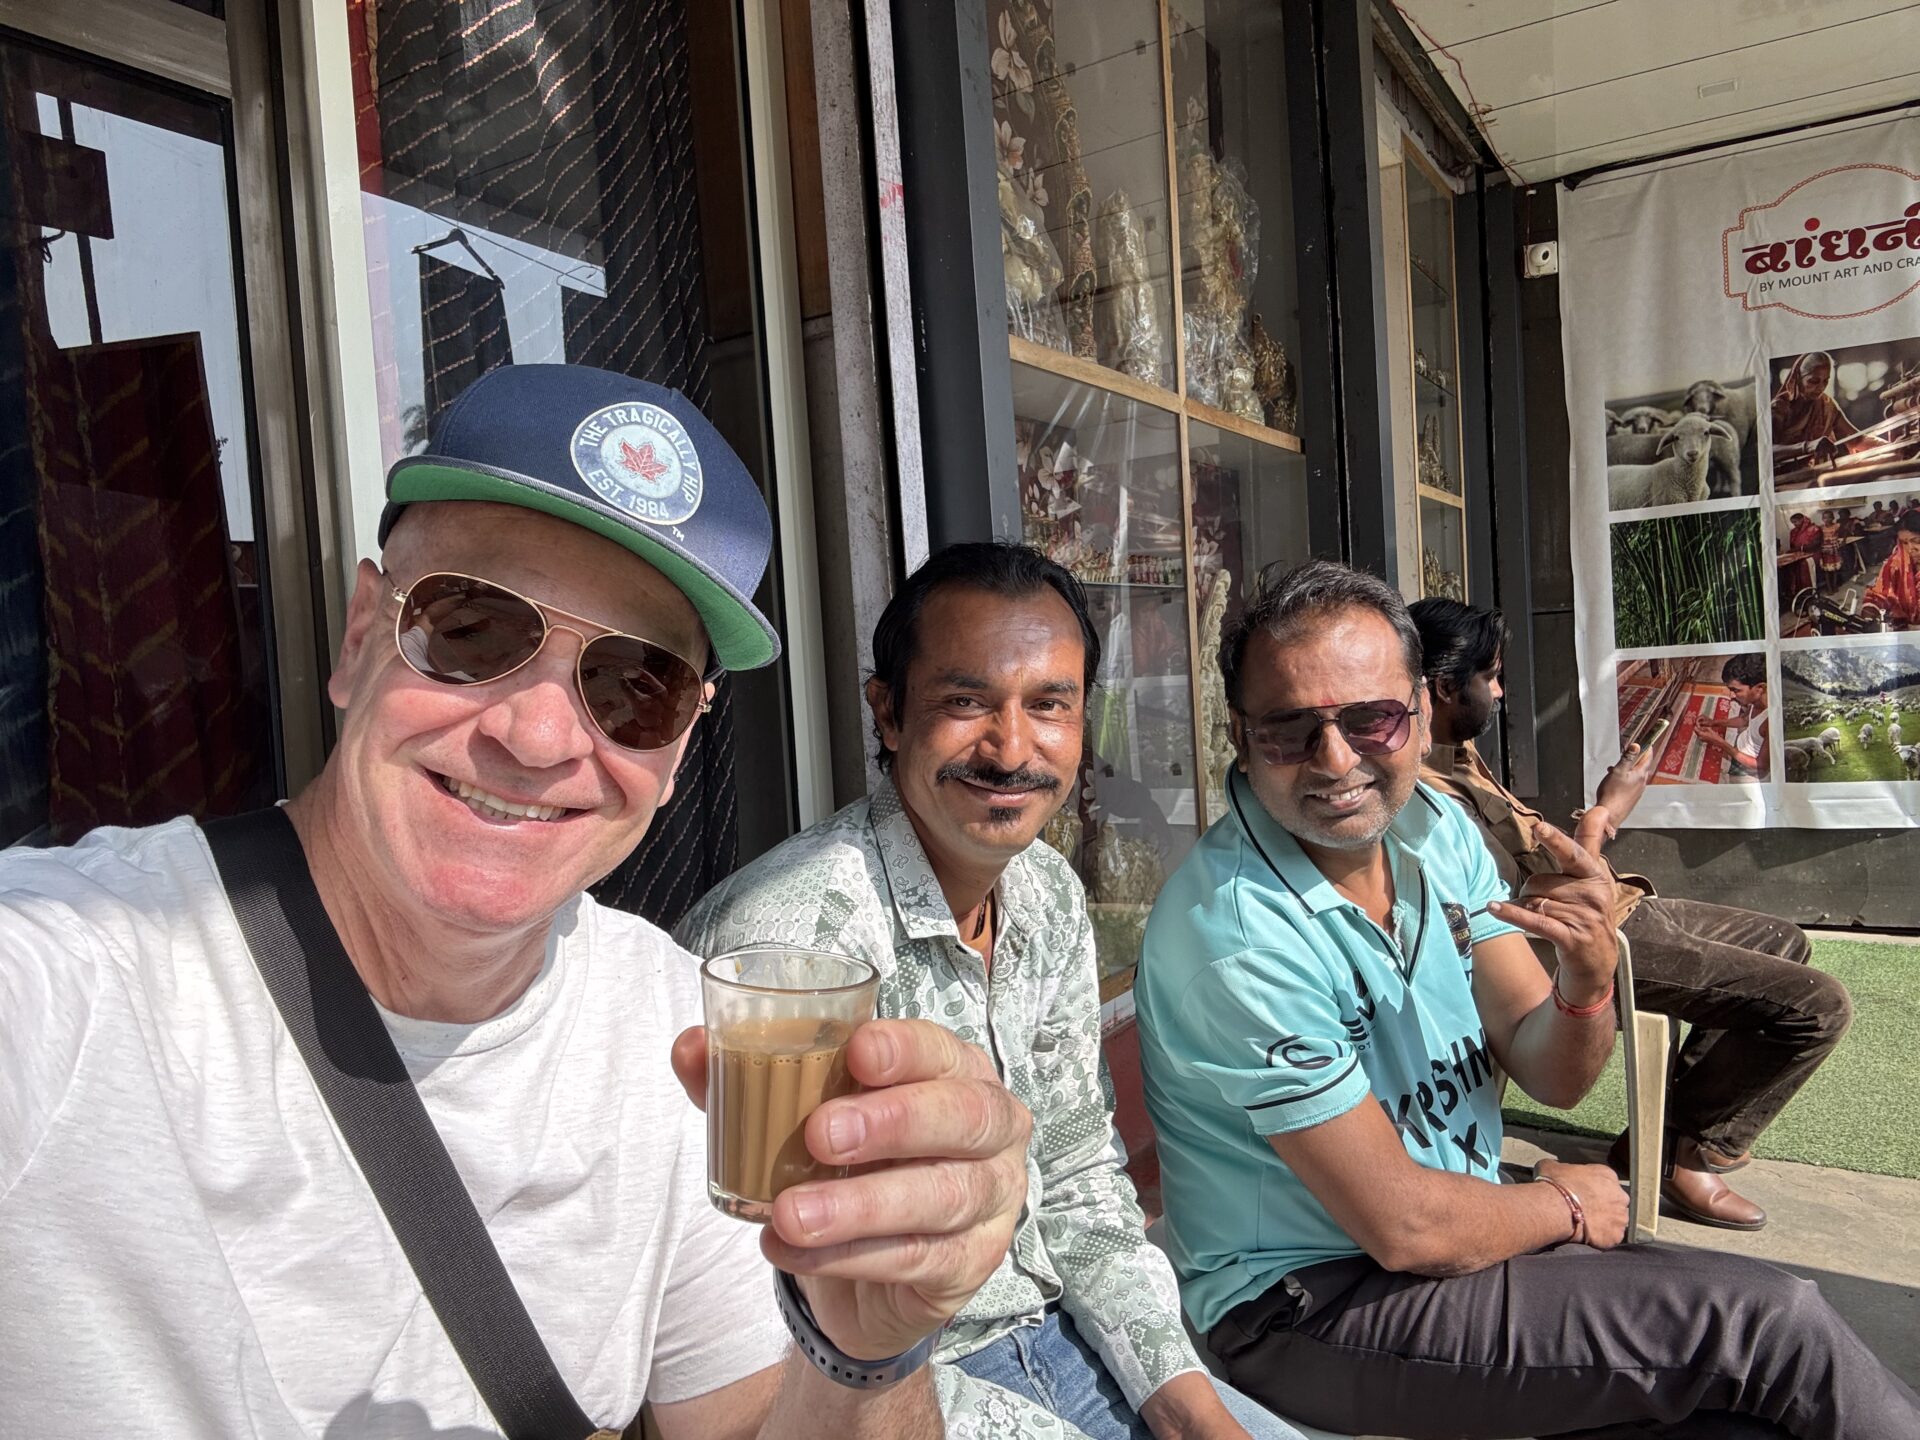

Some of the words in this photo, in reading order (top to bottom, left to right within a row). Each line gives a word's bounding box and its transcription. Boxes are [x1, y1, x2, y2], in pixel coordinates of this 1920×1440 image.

[1759, 281, 1775, 293] BY
[1778, 271, 1830, 289] MOUNT
[1833, 266, 1860, 280] ART
[1863, 260, 1893, 275] AND
[579, 421, 609, 448] THE
[603, 407, 697, 471] TRAGICALLY
[681, 473, 699, 504] HIP
[588, 469, 625, 502] EST.
[628, 494, 670, 519] 1984
